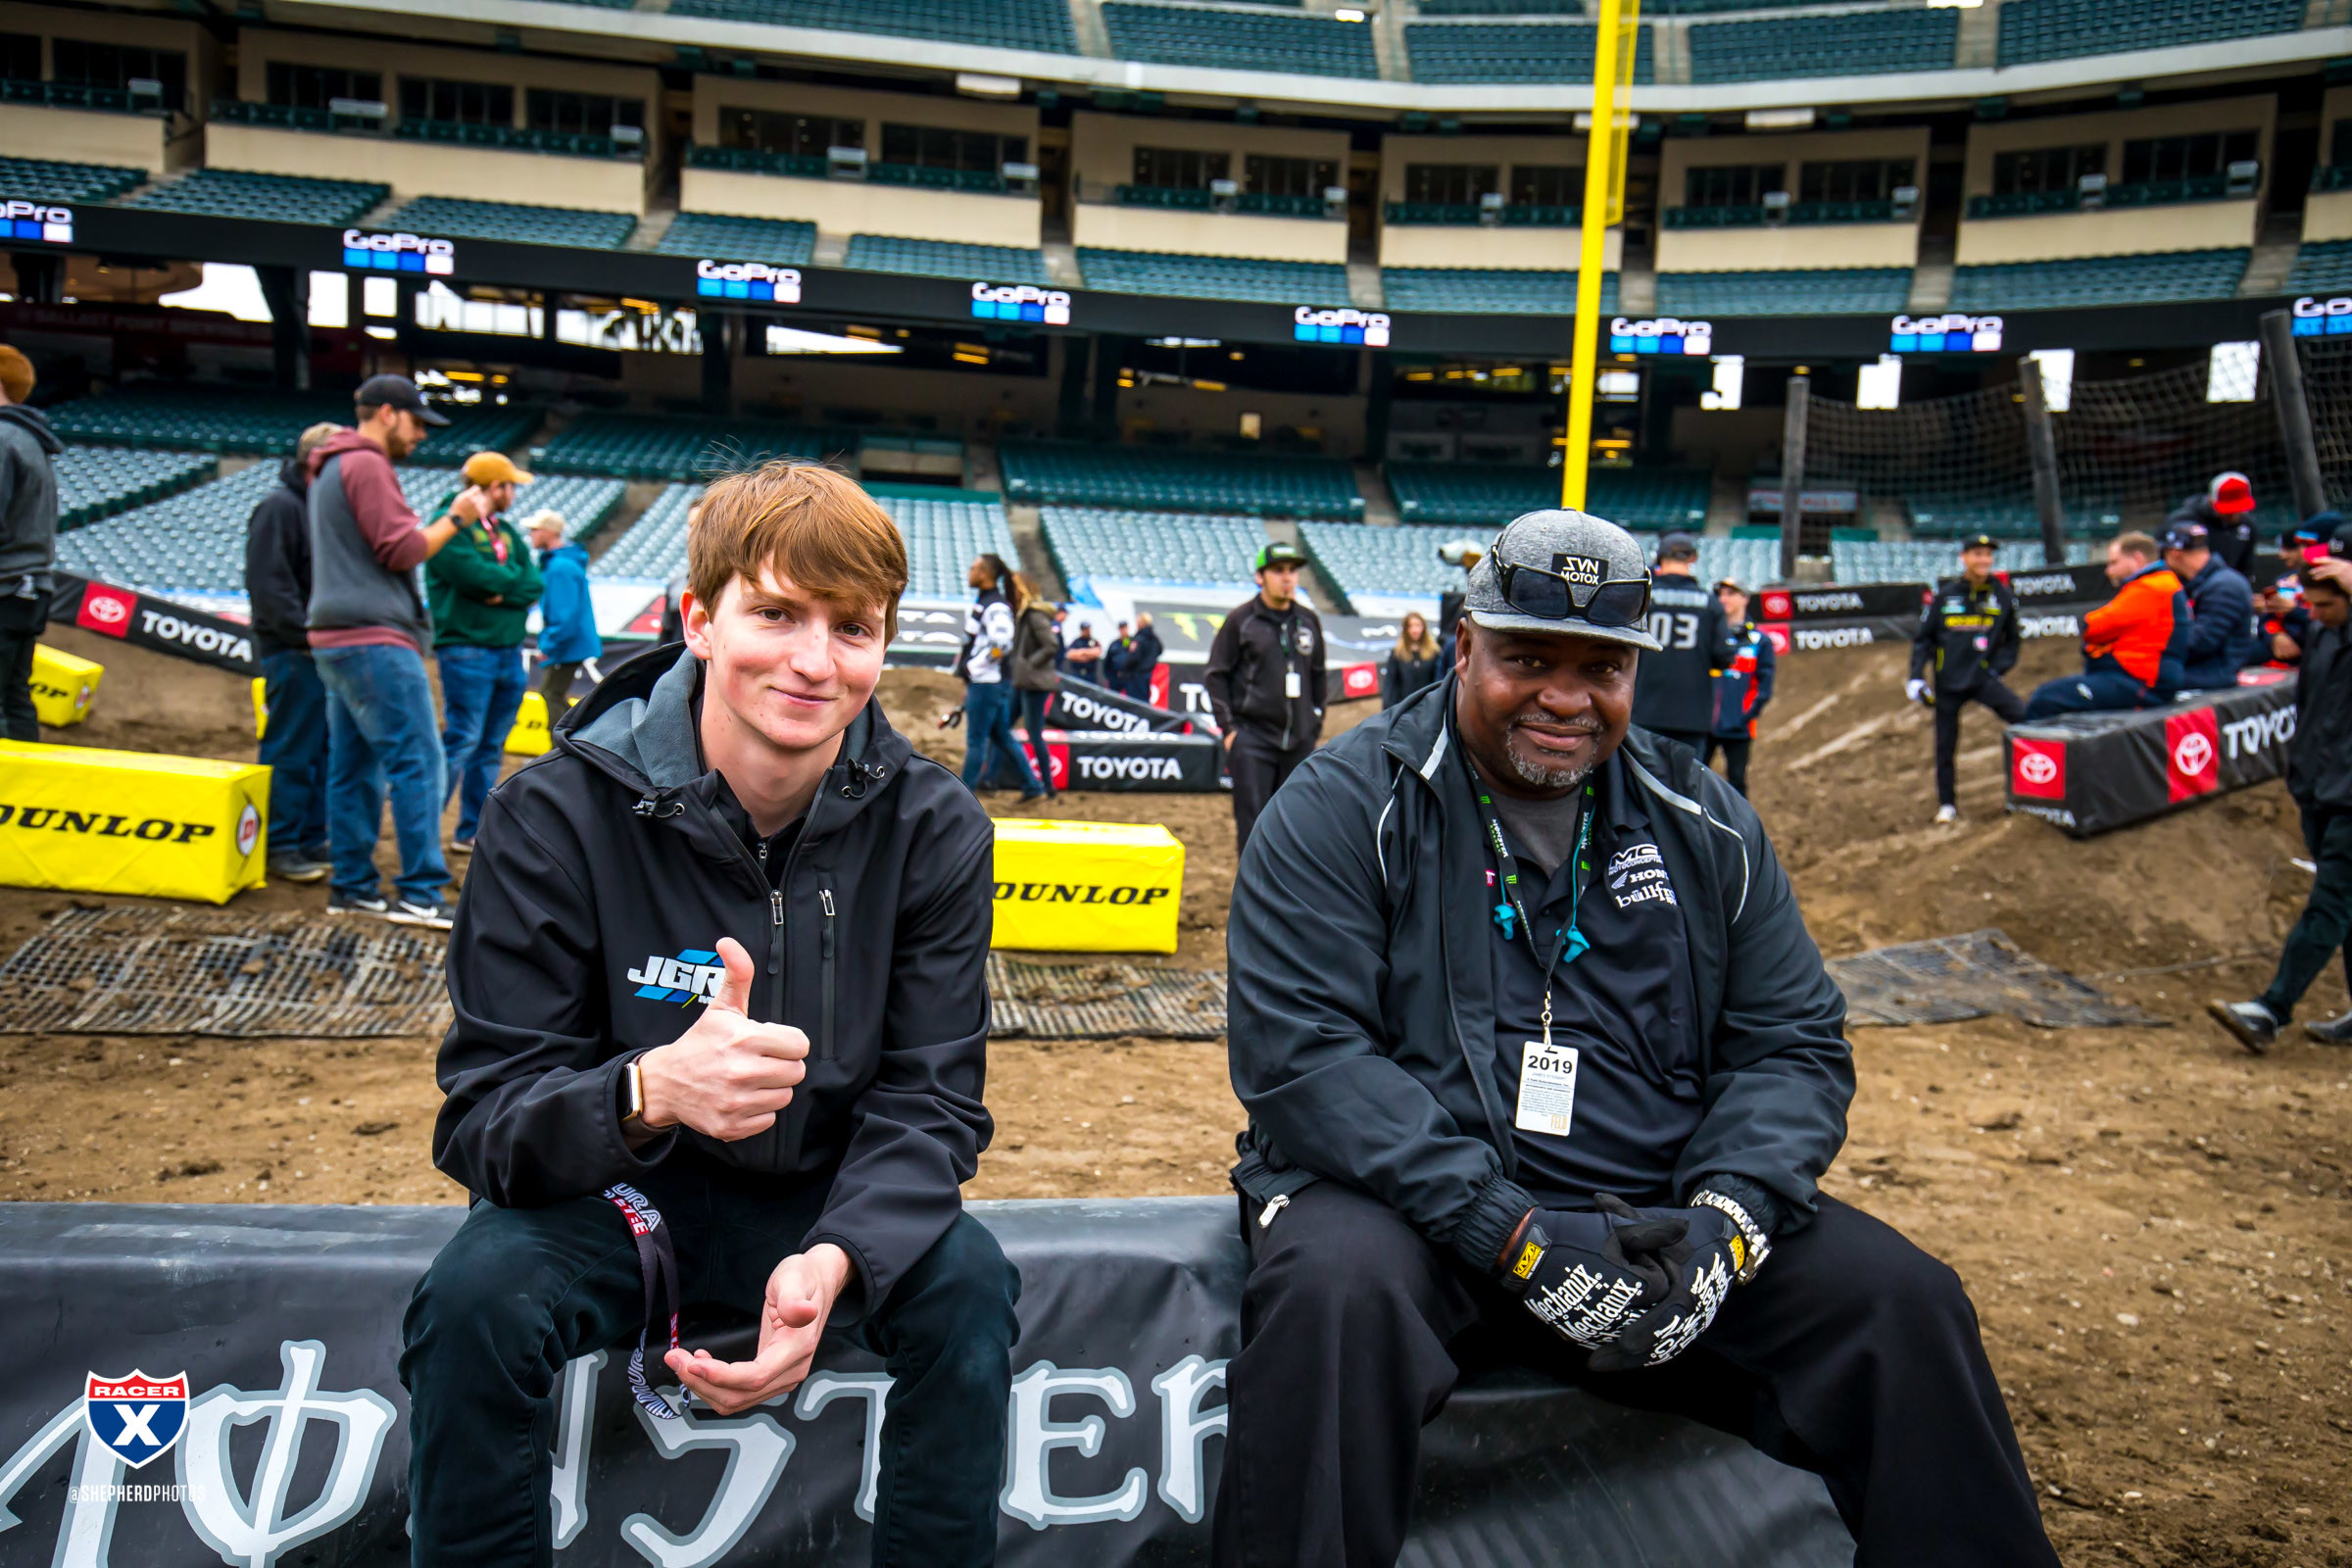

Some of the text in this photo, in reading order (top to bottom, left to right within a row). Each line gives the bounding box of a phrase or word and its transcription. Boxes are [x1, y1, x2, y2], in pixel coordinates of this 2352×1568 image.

[0, 200, 74, 224] Pro
[344, 229, 454, 256] GoPro
[698, 259, 801, 284] GoPro
[972, 281, 1070, 306] GoPro
[1295, 307, 1391, 329] GoPro
[1610, 318, 1712, 338] GoPro
[1891, 315, 2003, 336] GoPro
[1560, 570, 1599, 585] MOTOX
[1793, 592, 1864, 612] TOYOTA
[141, 609, 253, 663] TOYOTA
[1793, 627, 1874, 650] TOYOTA
[2017, 615, 2080, 639] OYOTA
[1060, 690, 1152, 733] TOYOTA
[2223, 704, 2297, 760] TOYO
[1076, 756, 1183, 781] TOYOTA
[1630, 868, 1669, 883] HON
[993, 882, 1170, 906] DUNLOP
[1527, 1054, 1573, 1074] 2019
[1524, 1263, 1598, 1325] Mechanix
[1556, 1277, 1639, 1344] Mechanix
